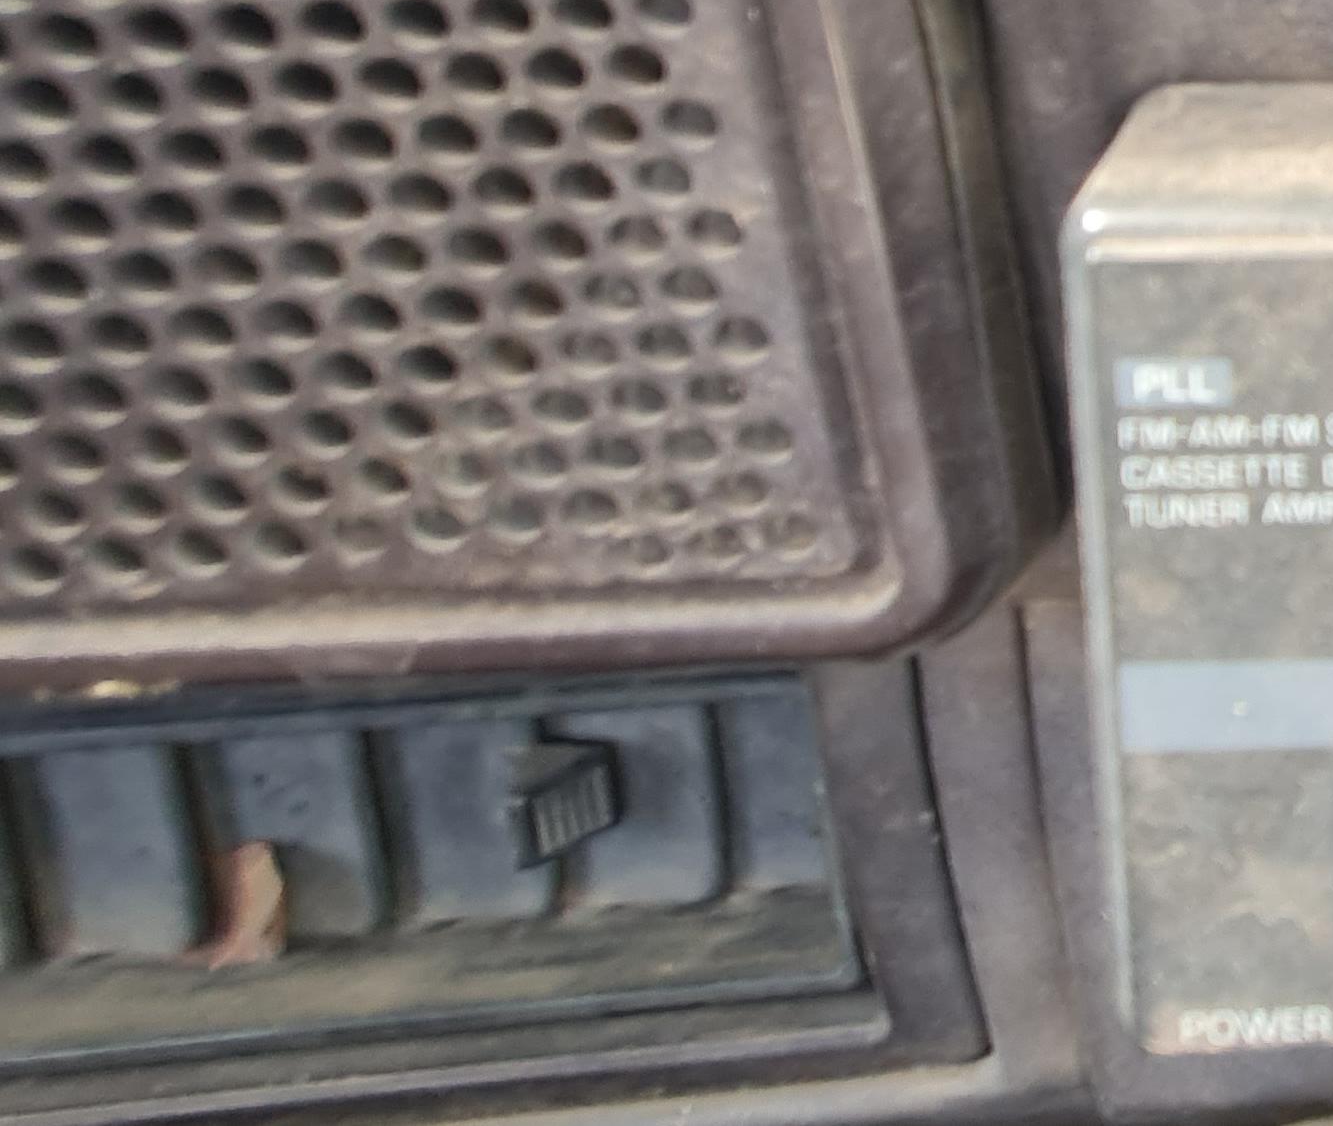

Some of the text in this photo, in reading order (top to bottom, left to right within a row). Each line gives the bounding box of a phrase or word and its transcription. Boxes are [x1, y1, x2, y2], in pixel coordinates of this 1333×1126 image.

[1133, 363, 1217, 402] PLL
[1120, 454, 1309, 490] CASSETTE
[1123, 491, 1250, 528] TUNER
